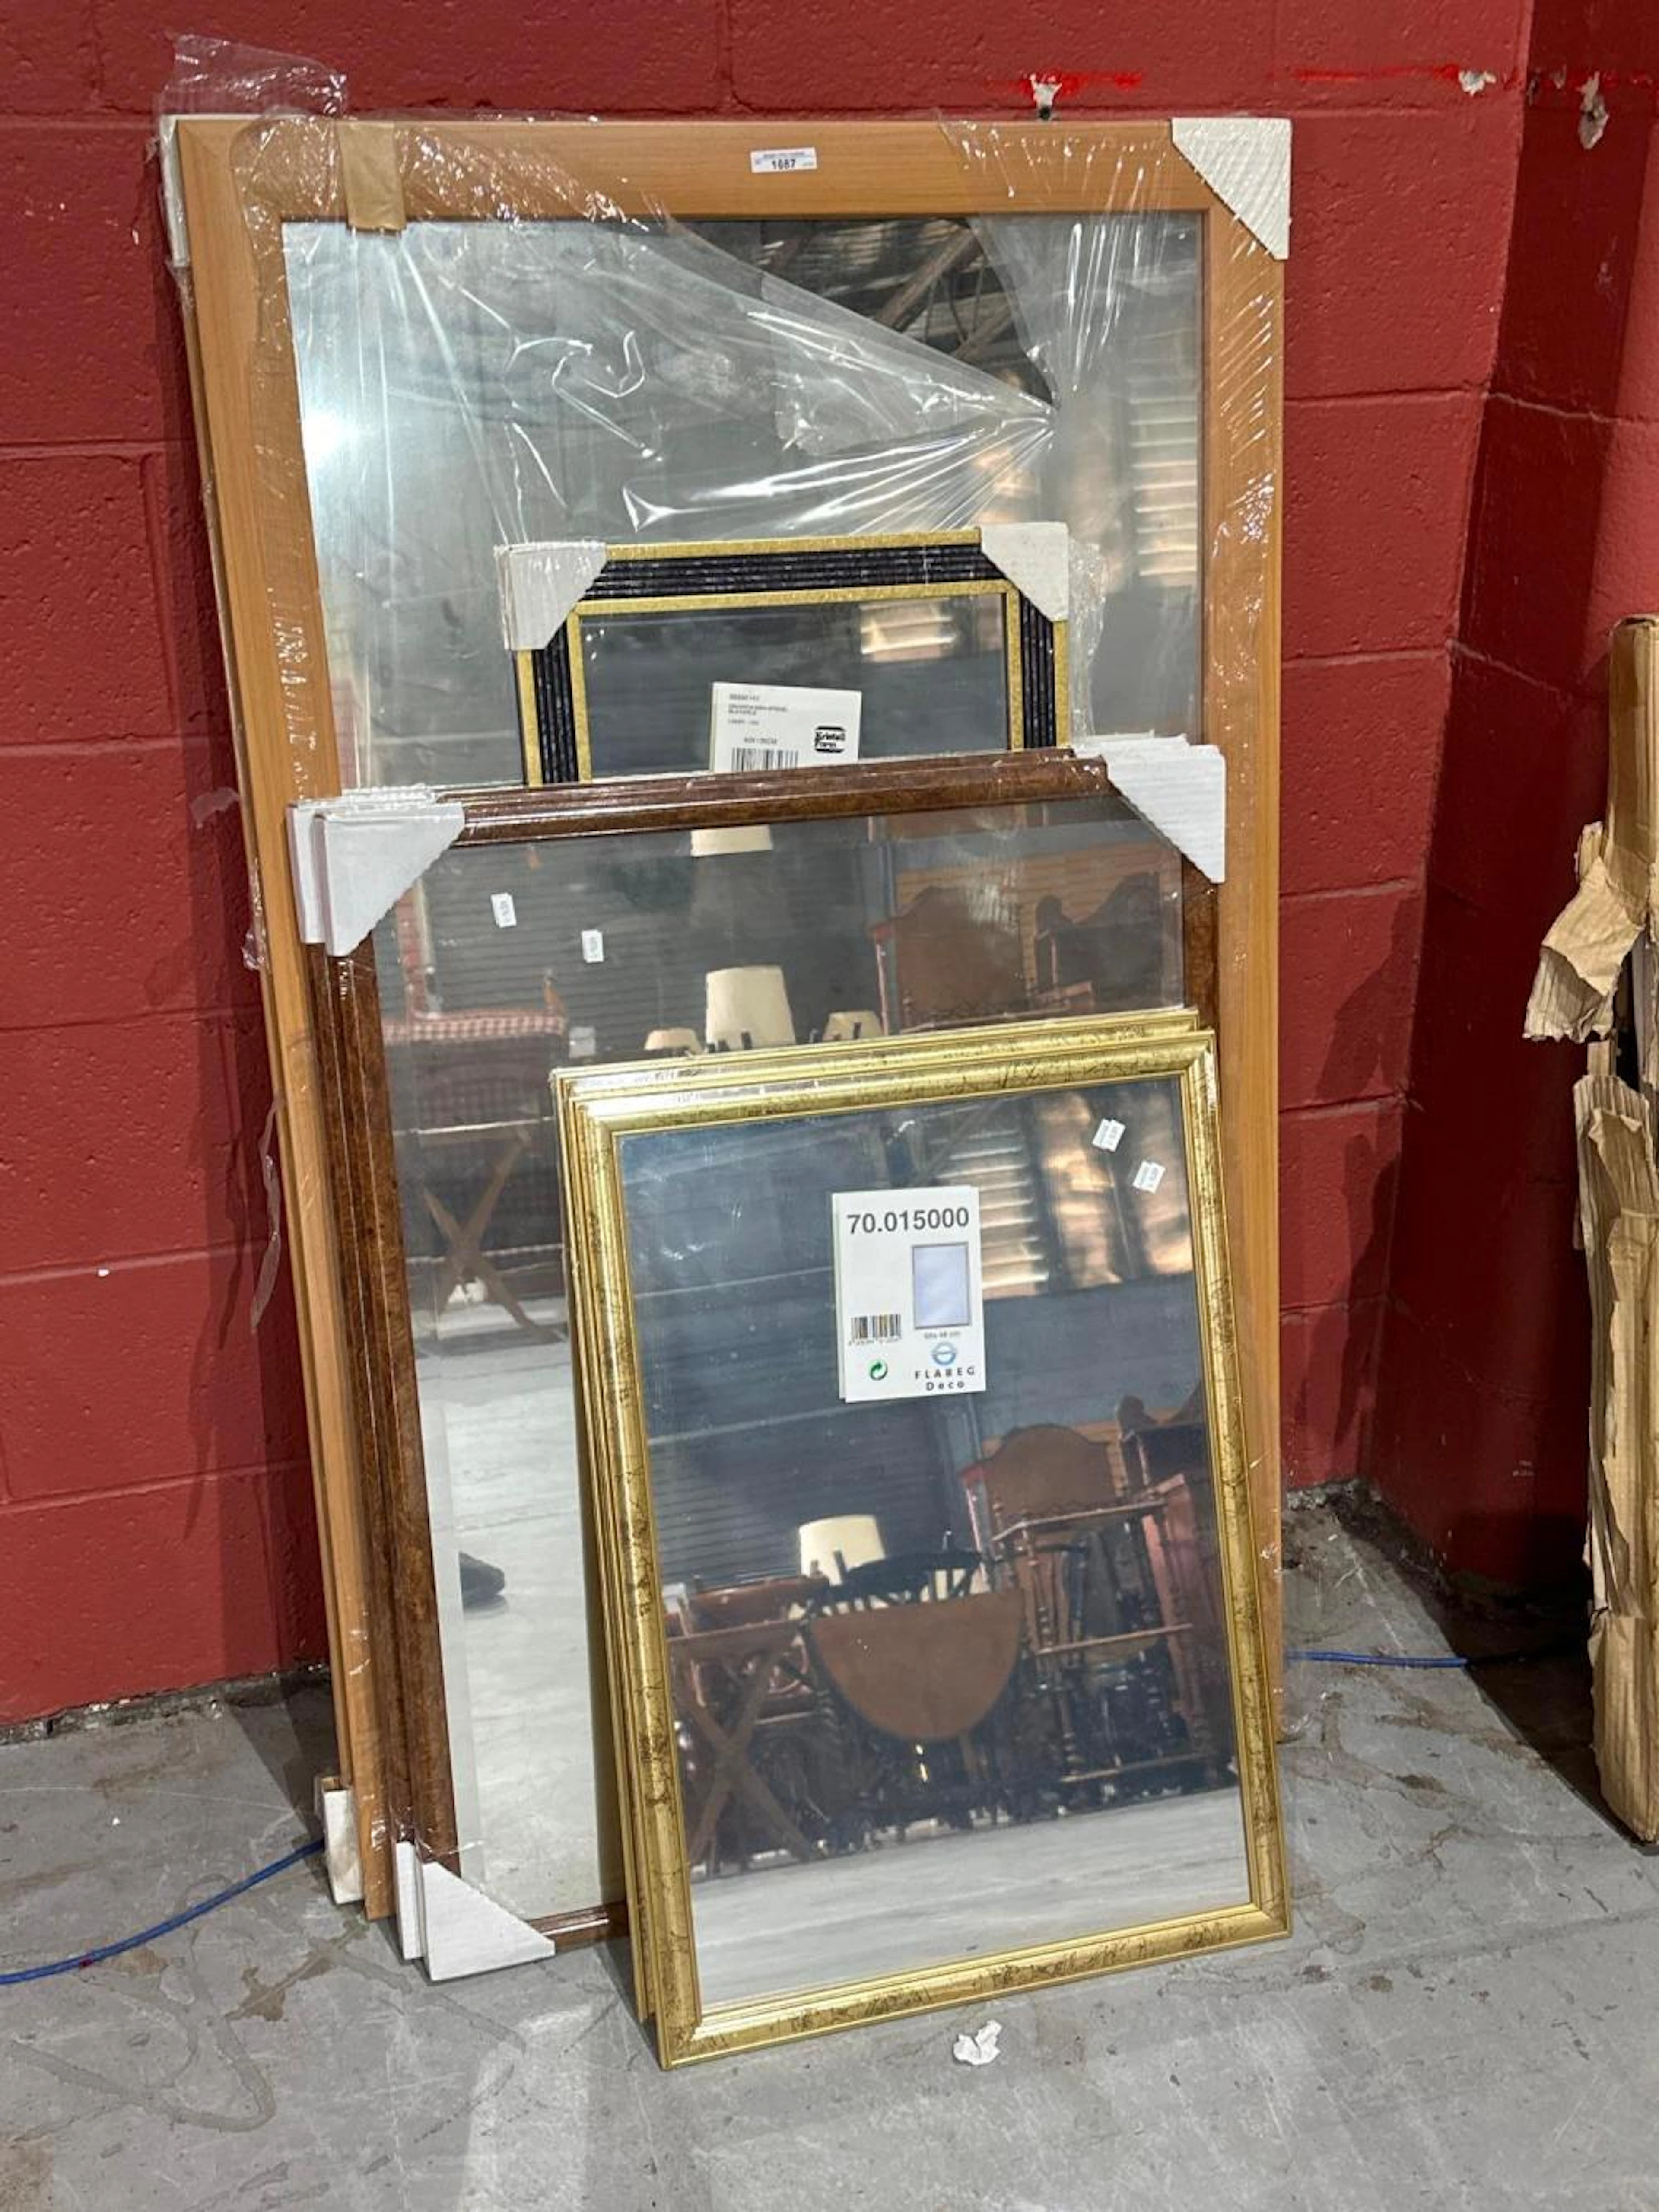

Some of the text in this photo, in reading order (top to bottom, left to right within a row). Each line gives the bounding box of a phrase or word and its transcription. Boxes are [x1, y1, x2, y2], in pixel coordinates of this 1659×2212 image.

[847, 1207, 969, 1234] 70.015000
[915, 1365, 975, 1379] FLABEG
[926, 1381, 964, 1391] Deco
